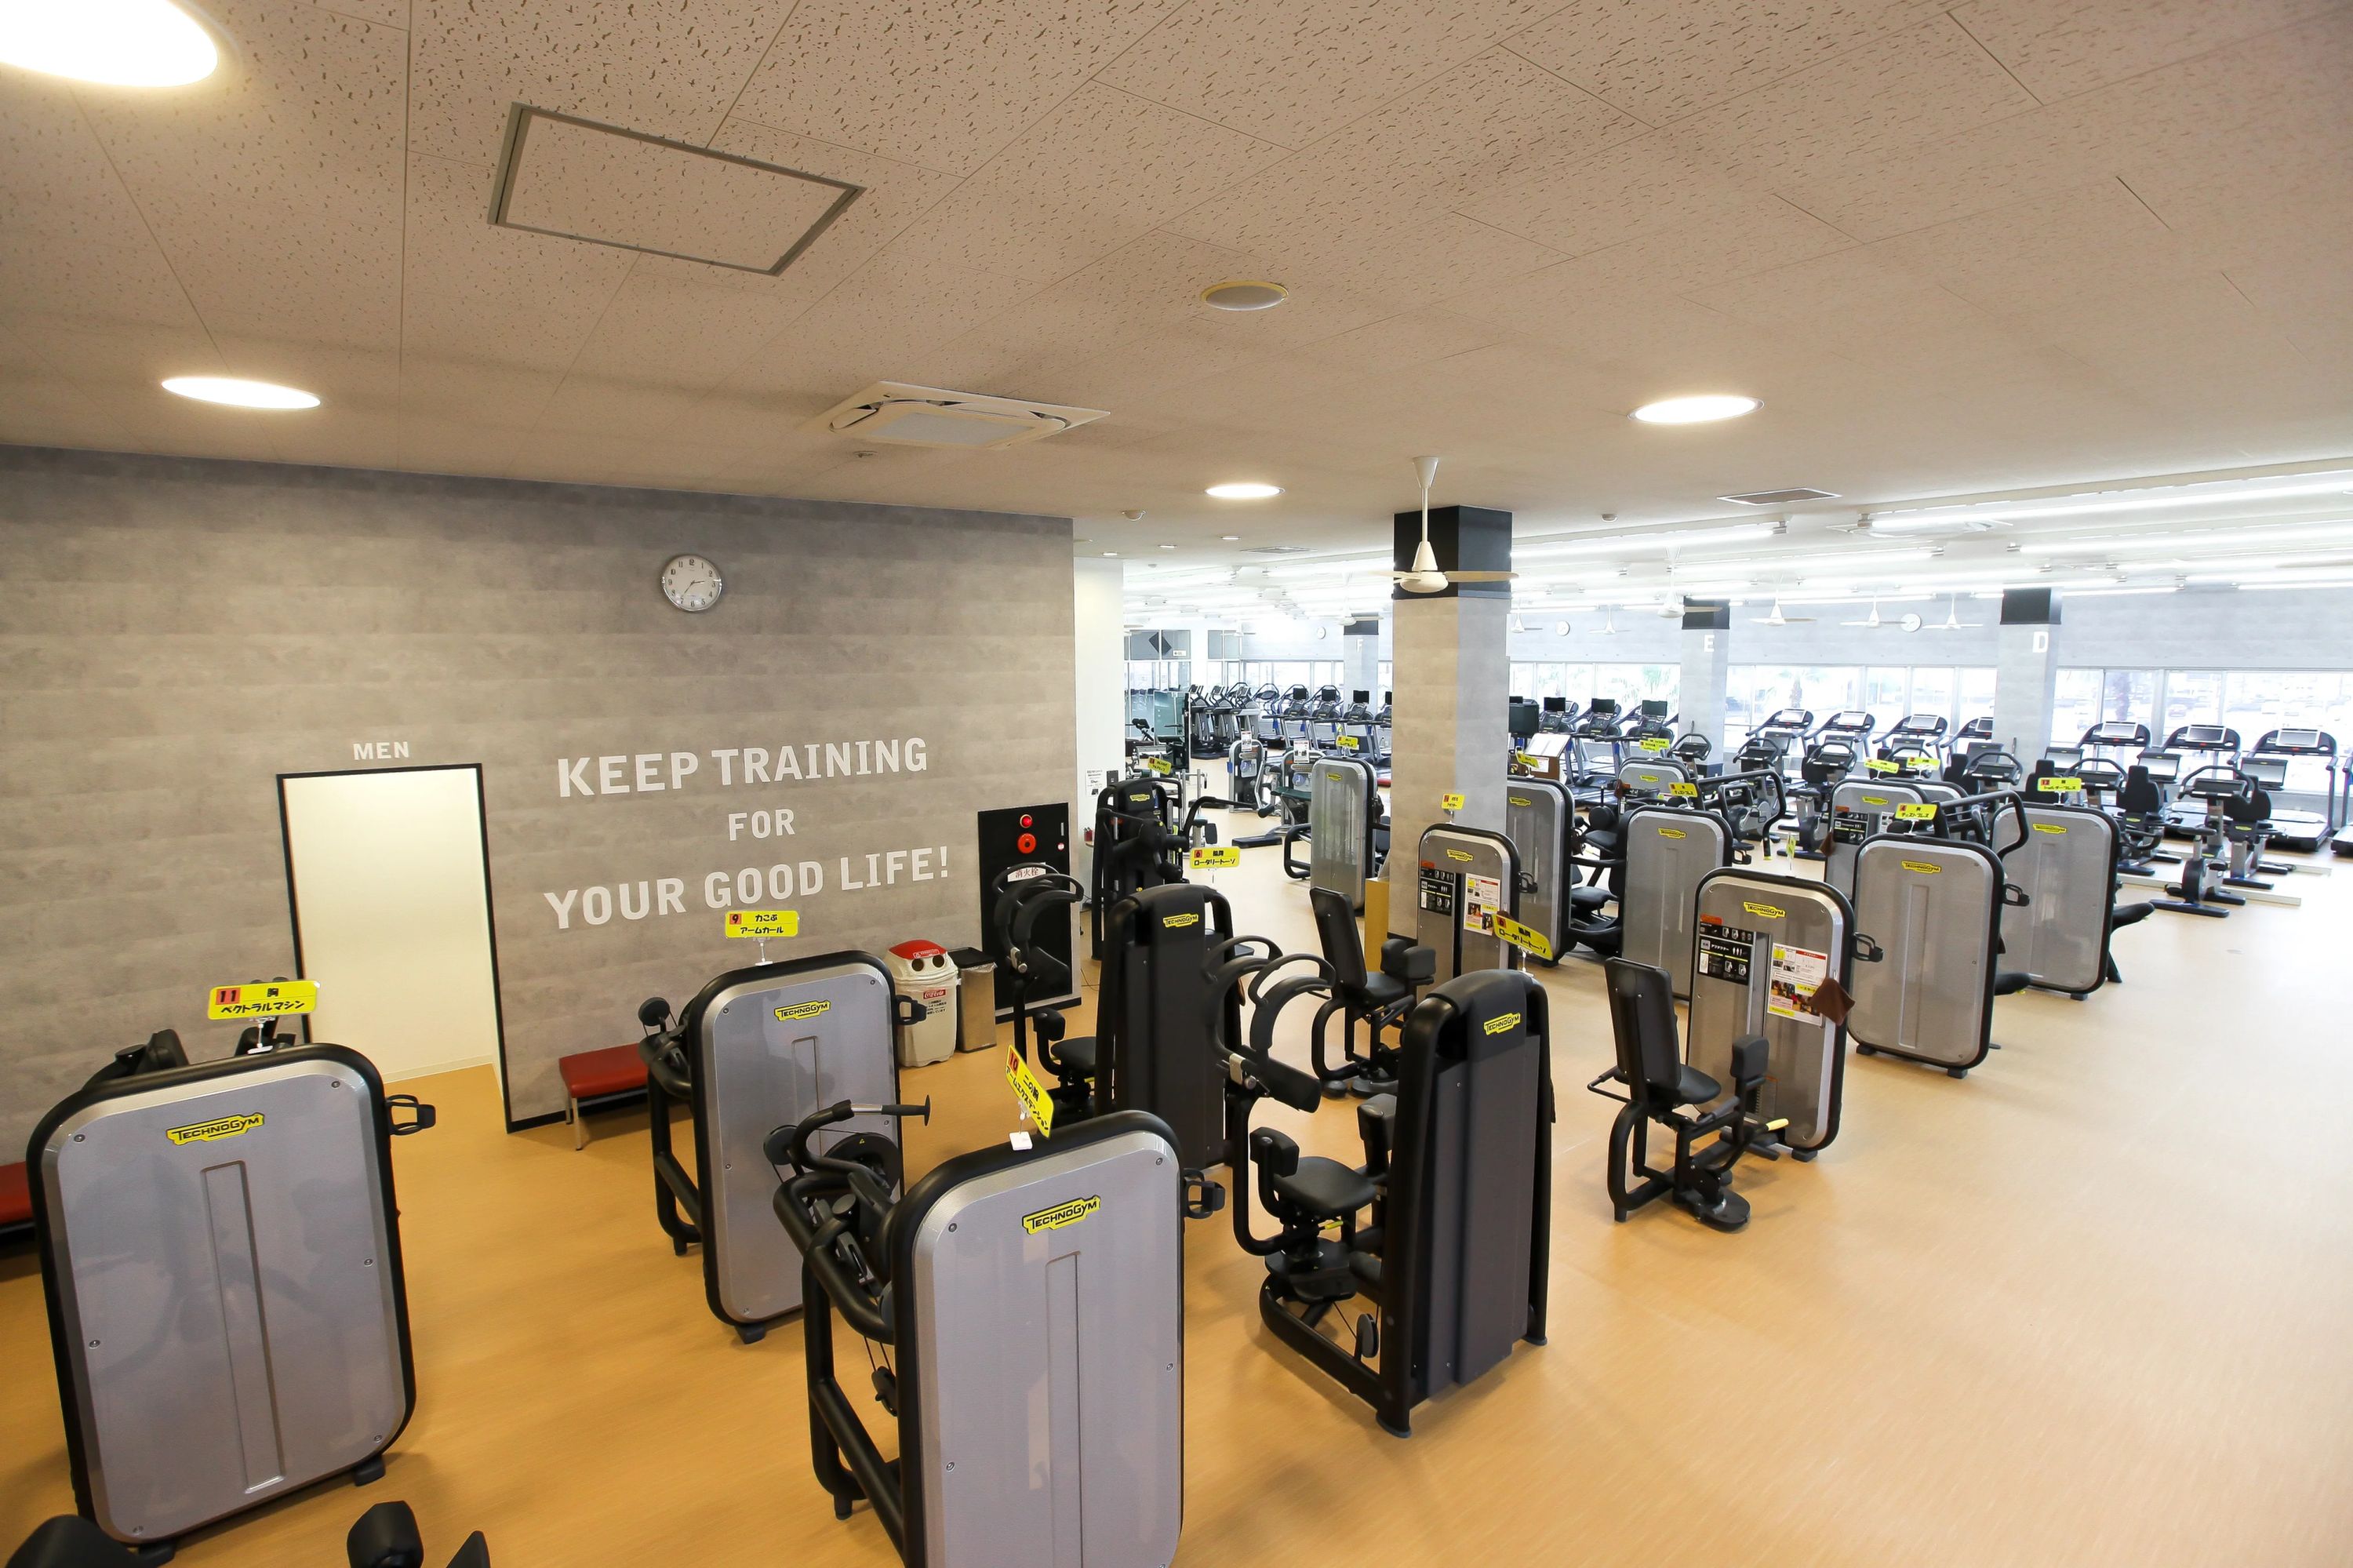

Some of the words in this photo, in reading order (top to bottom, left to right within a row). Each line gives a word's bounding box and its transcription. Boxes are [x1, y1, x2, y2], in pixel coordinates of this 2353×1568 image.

[1704, 635, 1715, 652] E
[2032, 631, 2049, 653] D
[353, 741, 409, 760] MEN
[557, 751, 699, 798] KEEP
[711, 737, 928, 786] TRAINING
[727, 808, 796, 842] FOR
[1016, 866, 1039, 879] 消火栓
[544, 877, 687, 930] YOUR
[705, 860, 824, 910] GOOD
[839, 846, 950, 892] LIFE!
[1744, 903, 1784, 916] TECHNOGYM
[732, 914, 739, 924] 9
[1499, 929, 1546, 954] ロータリートーソ
[220, 990, 237, 1002] 11
[220, 1000, 305, 1013] ペクトラルマシン
[777, 1003, 828, 1017] TECHNOGYM
[1486, 1015, 1519, 1032] TECHNOGYM
[1009, 1053, 1018, 1071] 10
[1006, 1065, 1049, 1130] アームエクステンション
[171, 1117, 260, 1141] TECHNOGYM
[1026, 1200, 1097, 1230] TECHNOGYM
